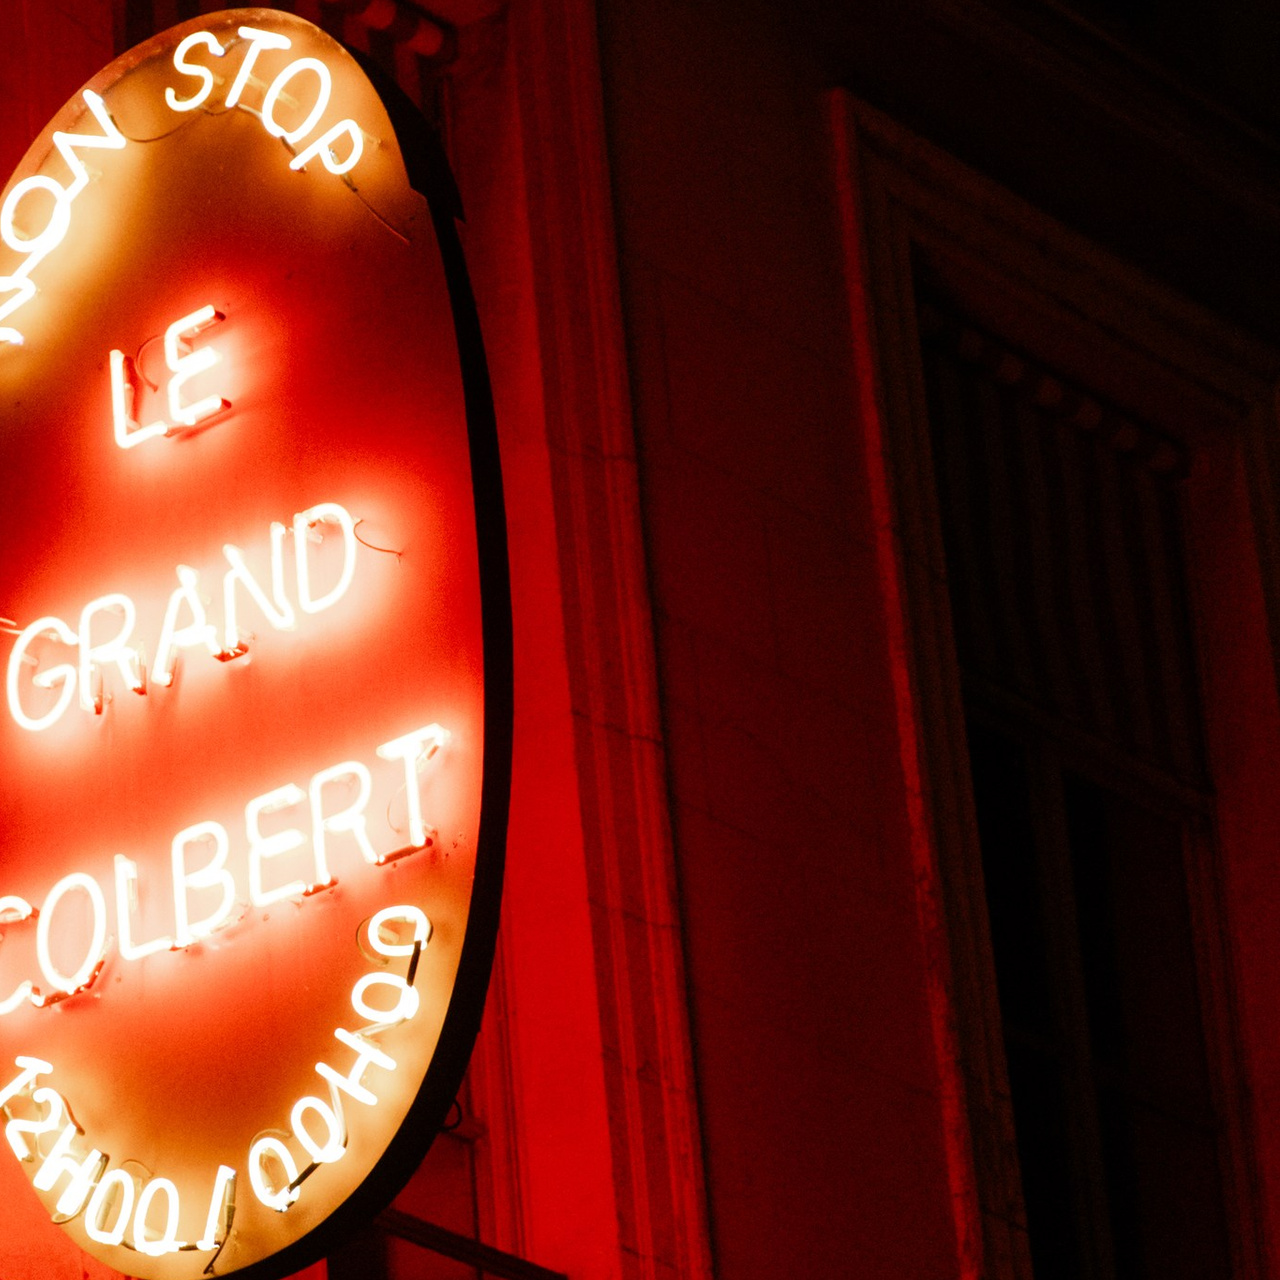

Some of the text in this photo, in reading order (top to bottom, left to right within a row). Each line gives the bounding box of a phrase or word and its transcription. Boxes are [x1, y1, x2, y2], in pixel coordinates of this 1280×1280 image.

[166, 26, 364, 175] STOP
[109, 304, 223, 450] LE
[6, 502, 358, 732] GRAND
